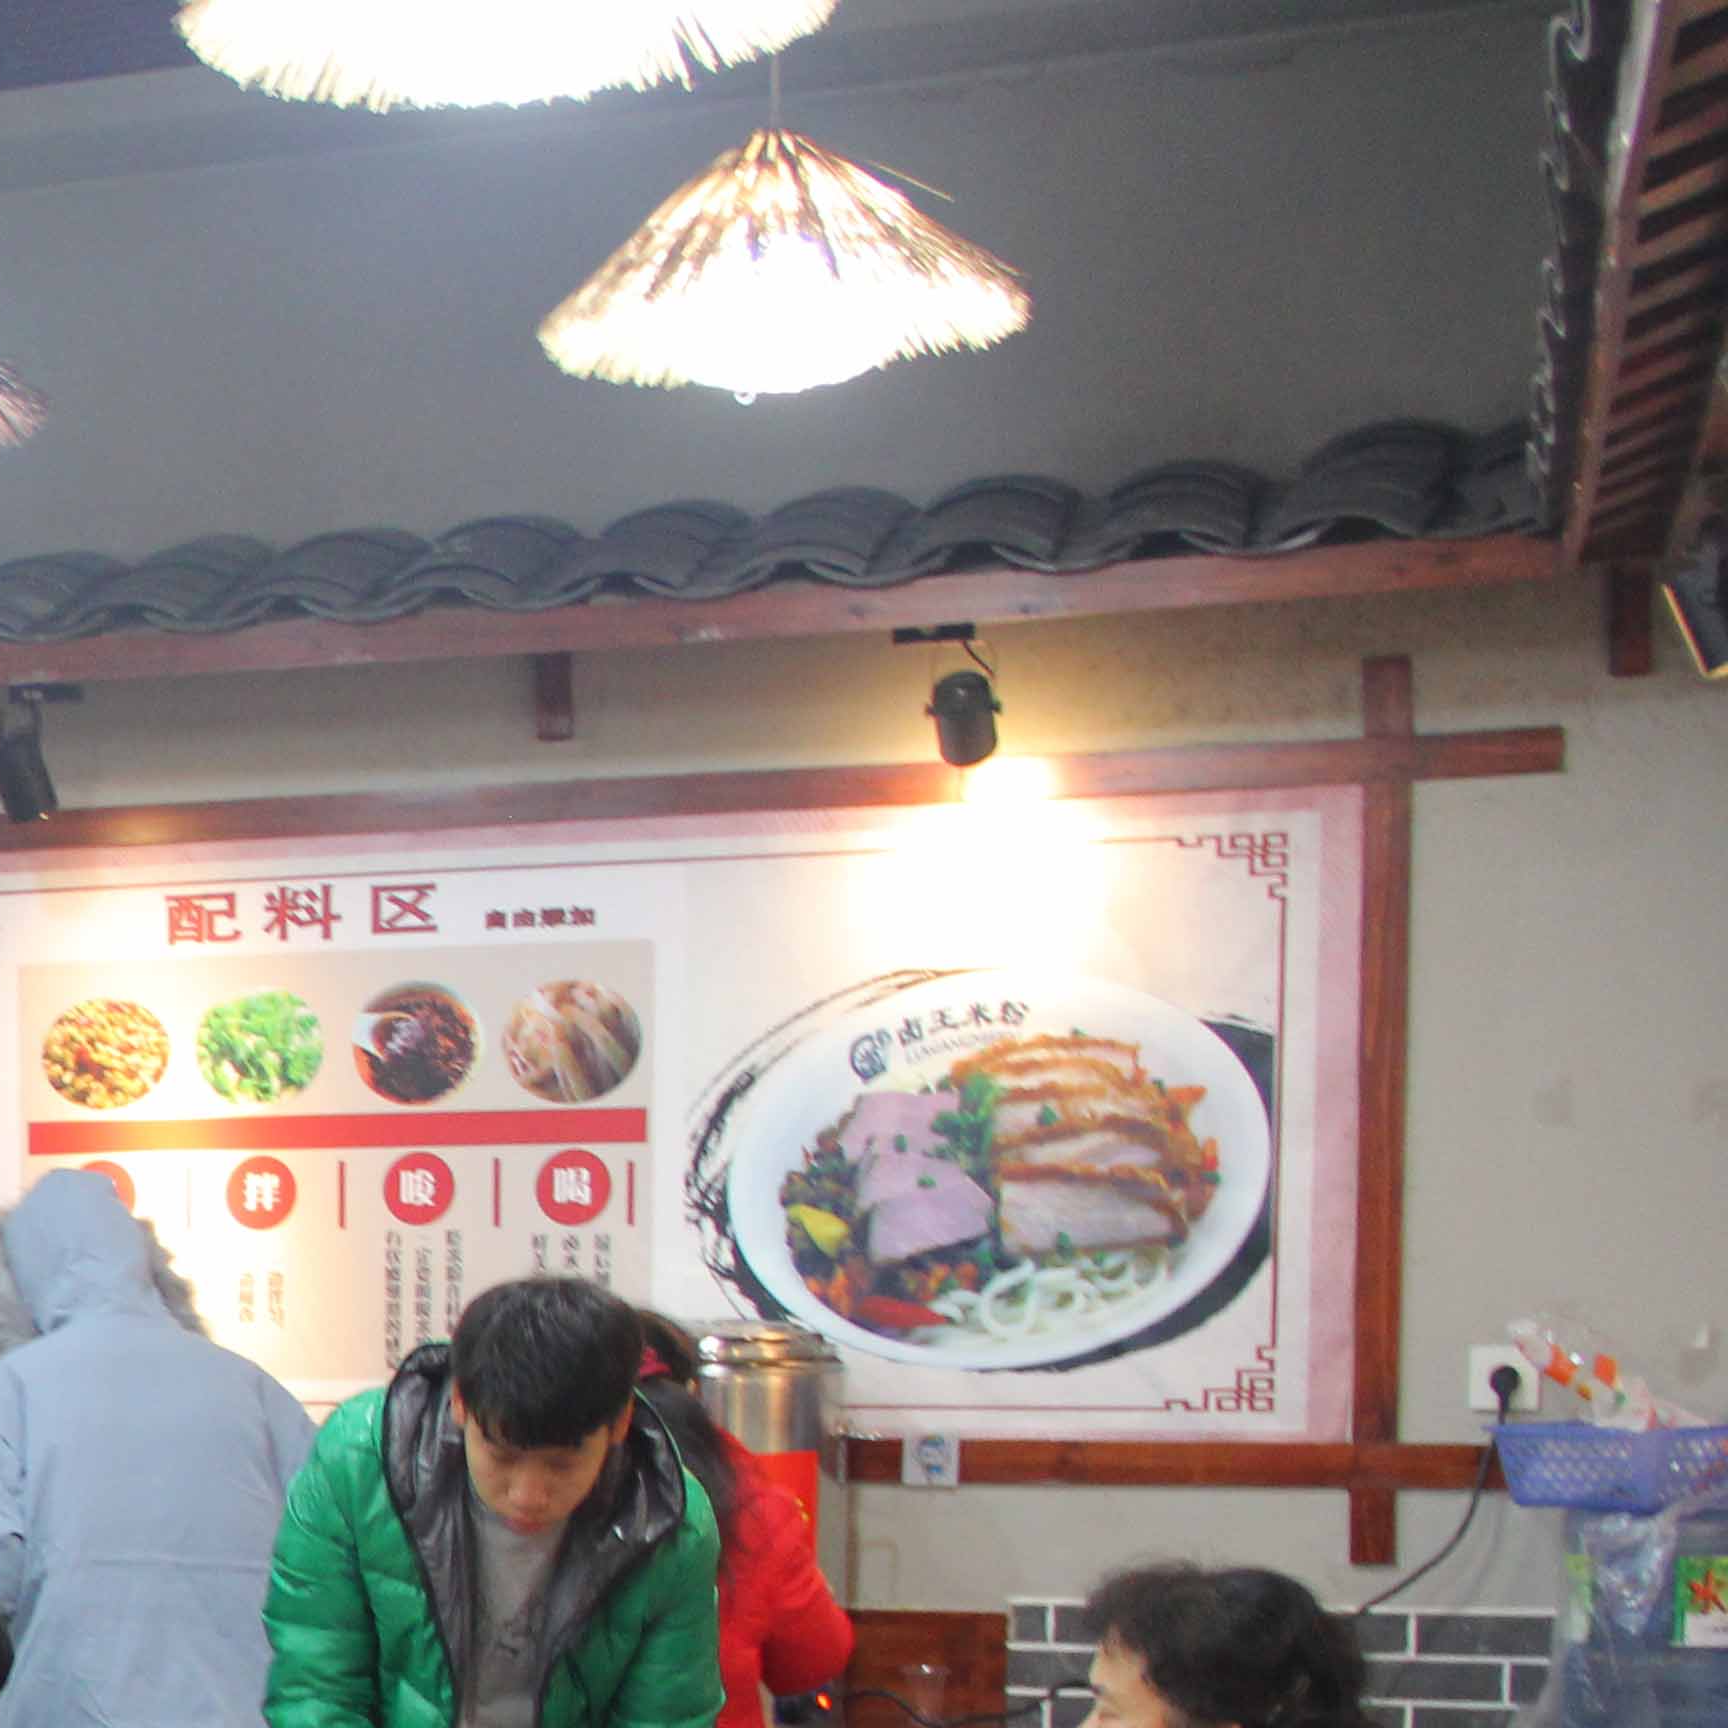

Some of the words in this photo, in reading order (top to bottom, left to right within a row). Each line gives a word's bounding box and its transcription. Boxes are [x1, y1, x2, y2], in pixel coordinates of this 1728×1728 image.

[163, 883, 438, 945] 配料区
[552, 1166, 592, 1206] 喝
